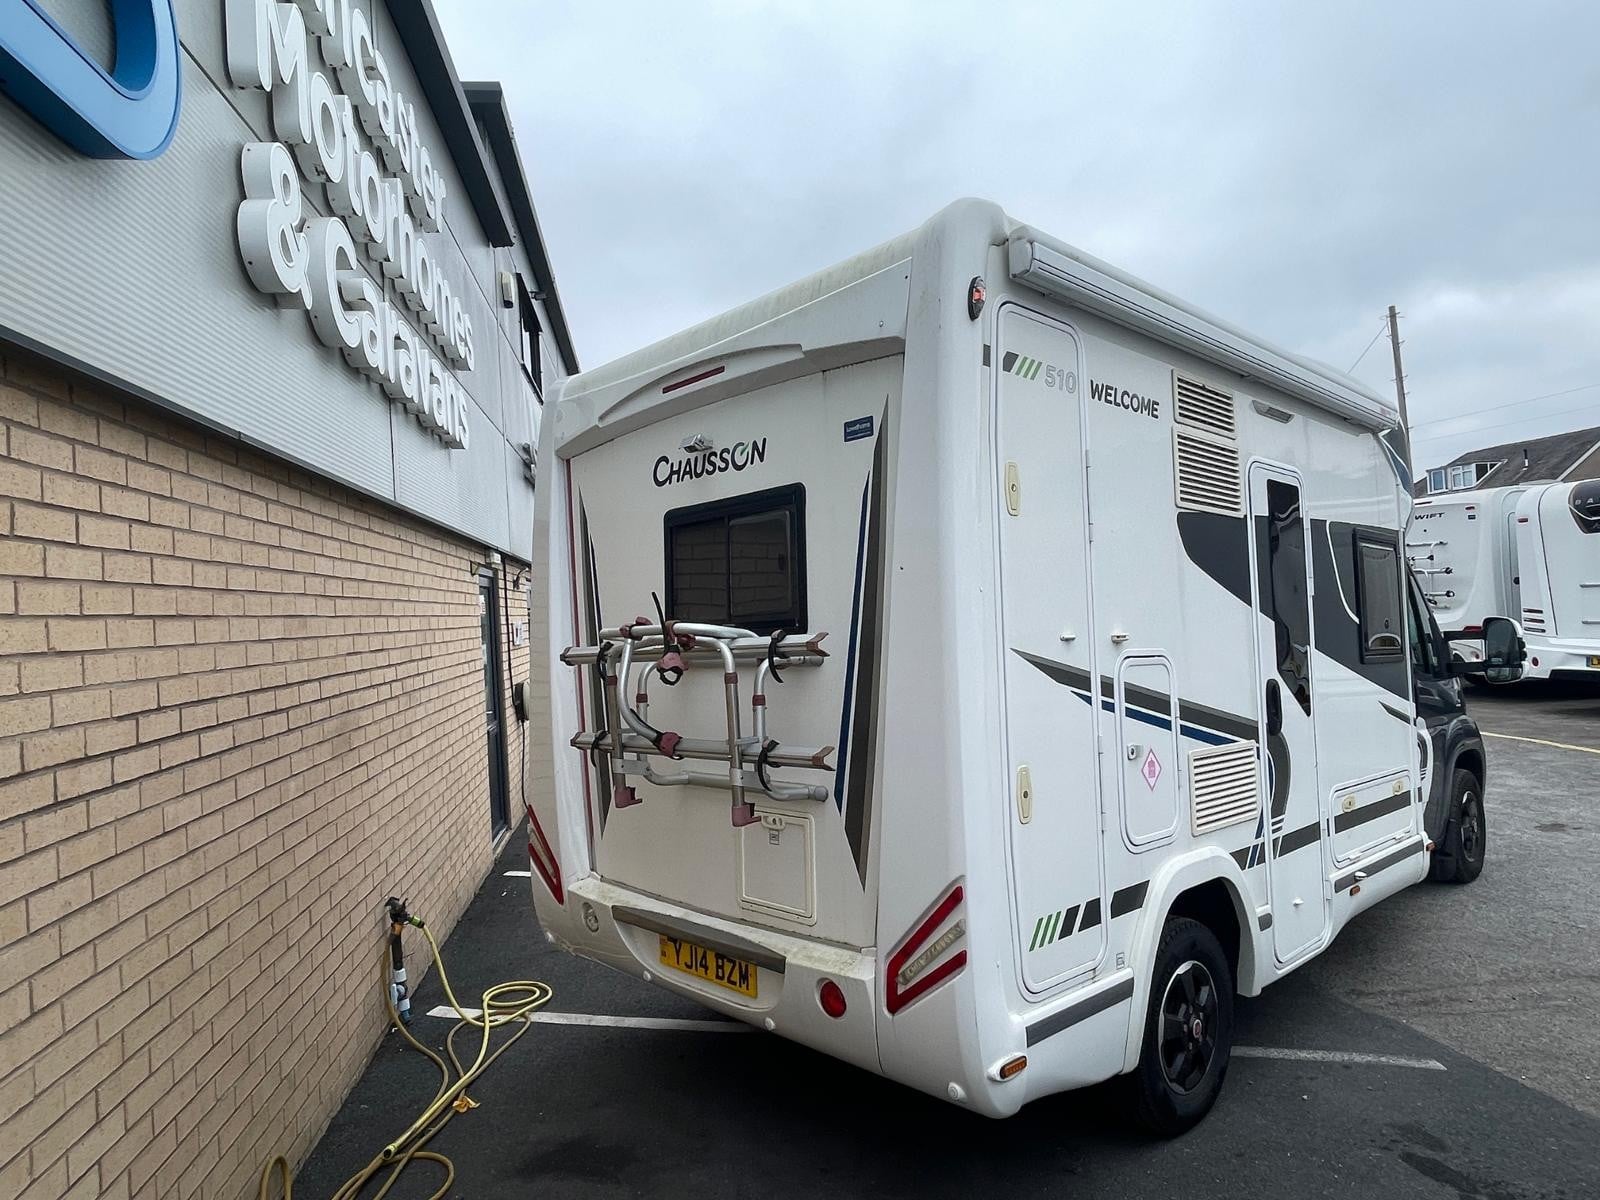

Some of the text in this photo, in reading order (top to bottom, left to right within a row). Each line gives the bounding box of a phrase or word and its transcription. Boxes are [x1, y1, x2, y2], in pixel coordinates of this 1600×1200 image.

[228, 0, 475, 372] Motorhomes
[238, 142, 470, 450] & Caravans
[1045, 364, 1077, 394] 510
[1090, 379, 1160, 420] WELCOME
[652, 437, 767, 487] CHAUSSON
[1415, 512, 1445, 520] WIFT
[667, 936, 750, 991] YJ14 BZM
